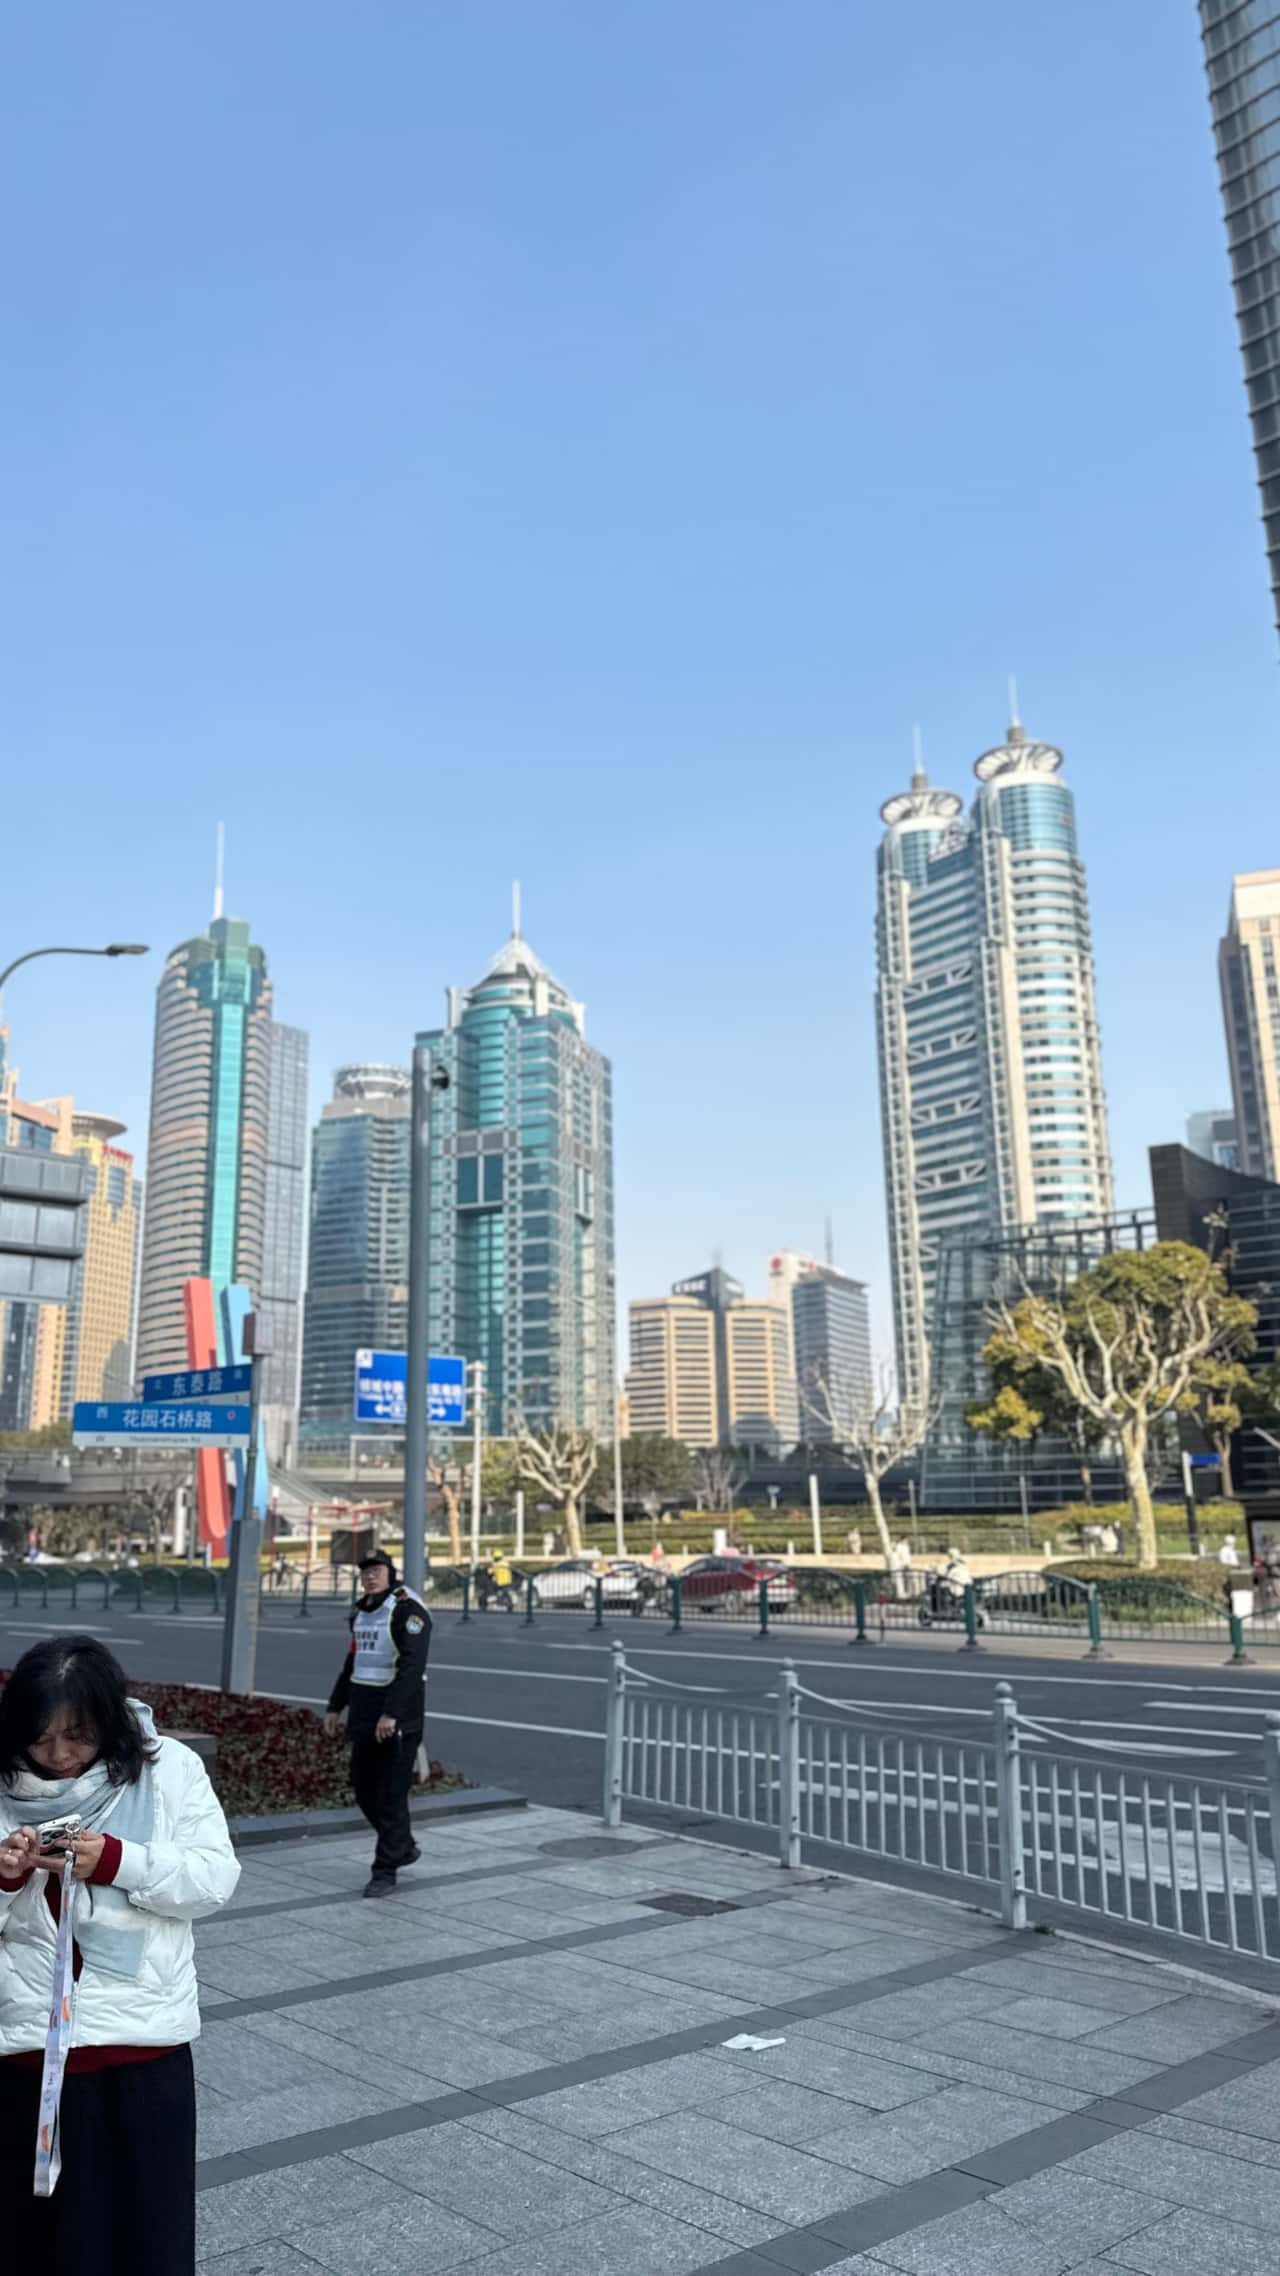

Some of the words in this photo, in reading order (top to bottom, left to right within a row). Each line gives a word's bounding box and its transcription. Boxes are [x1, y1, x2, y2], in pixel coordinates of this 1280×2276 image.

[172, 1370, 223, 1396] 东泰路
[96, 1406, 109, 1419] 西
[122, 1408, 213, 1429] 花园石桥路
